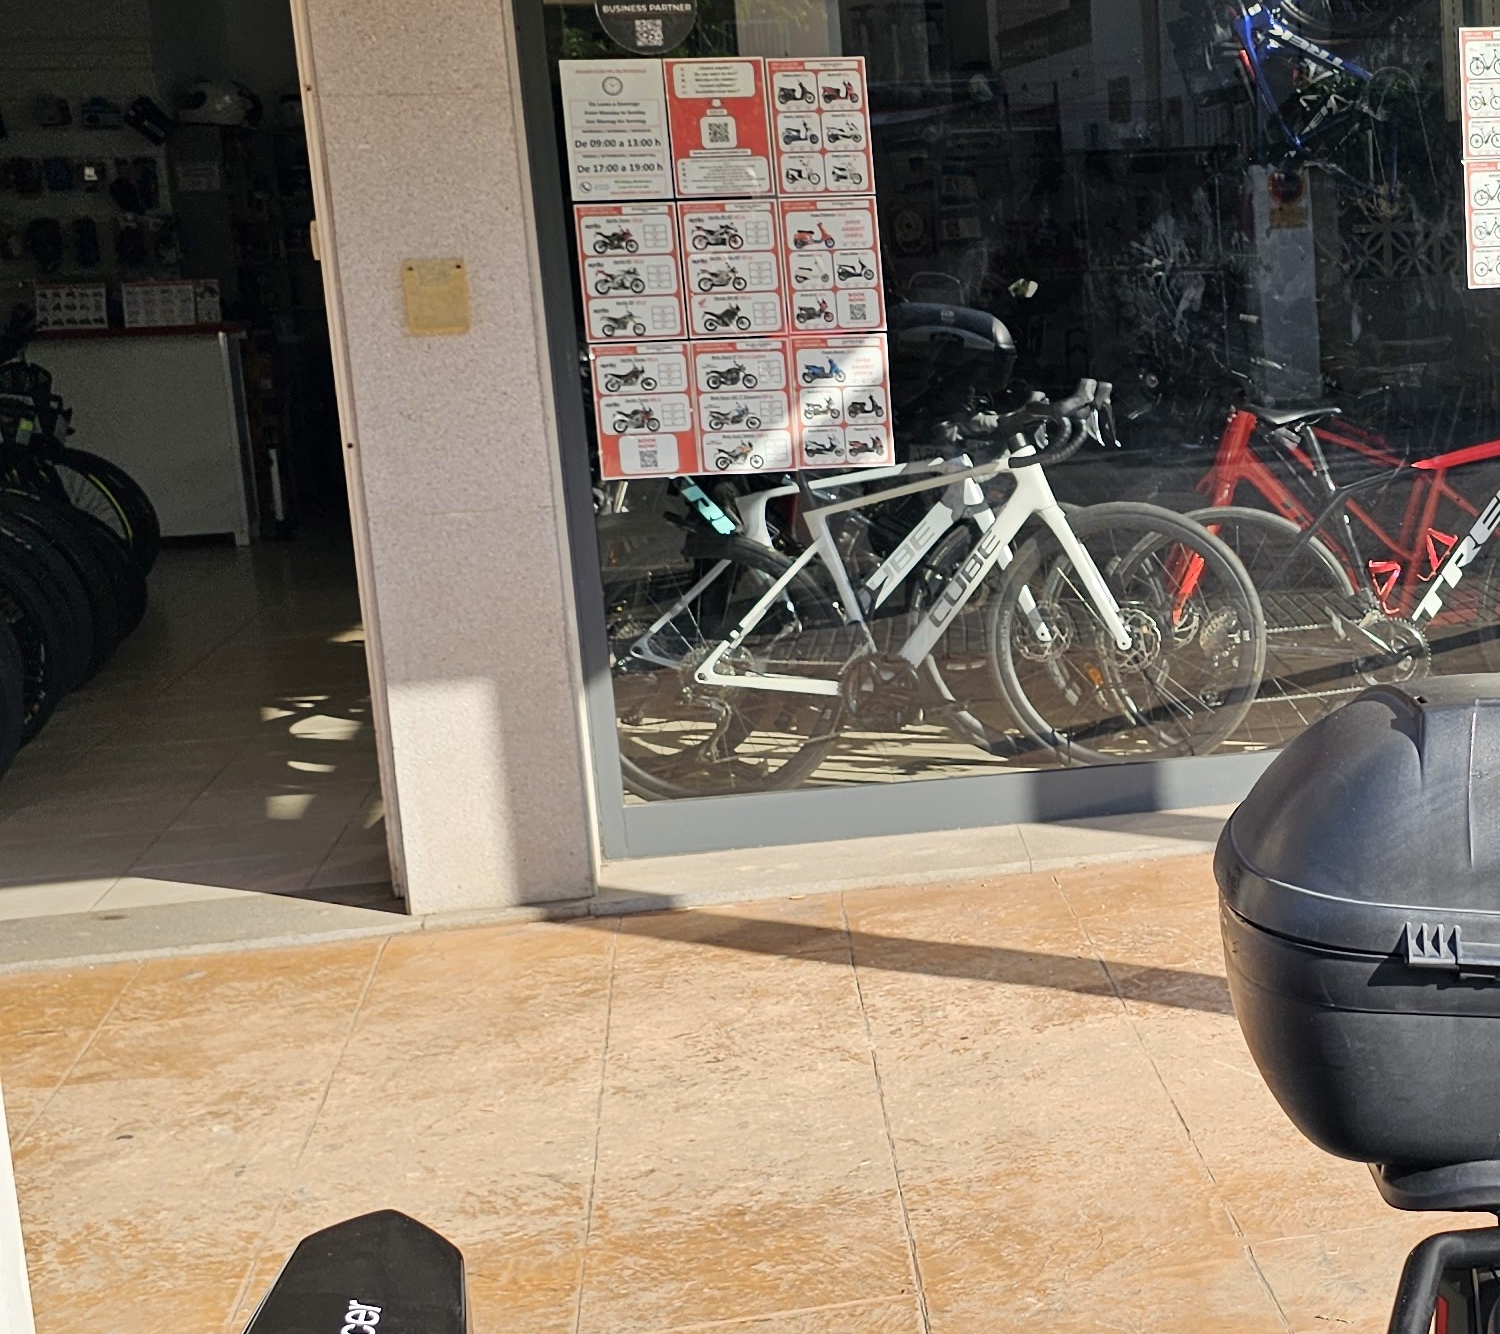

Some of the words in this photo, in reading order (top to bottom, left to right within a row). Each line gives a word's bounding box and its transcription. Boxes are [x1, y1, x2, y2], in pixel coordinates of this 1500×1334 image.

[602, 4, 647, 13] BUSINESS
[649, 3, 692, 12] PARTNER
[575, 140, 587, 148] De
[590, 139, 617, 148] 09:00
[627, 138, 653, 147] 13:00
[655, 138, 661, 146] h
[577, 165, 590, 173] De
[593, 164, 618, 173] 17:00
[629, 163, 654, 172] 19:00
[657, 163, 663, 171] h
[929, 529, 1001, 628] CUBE
